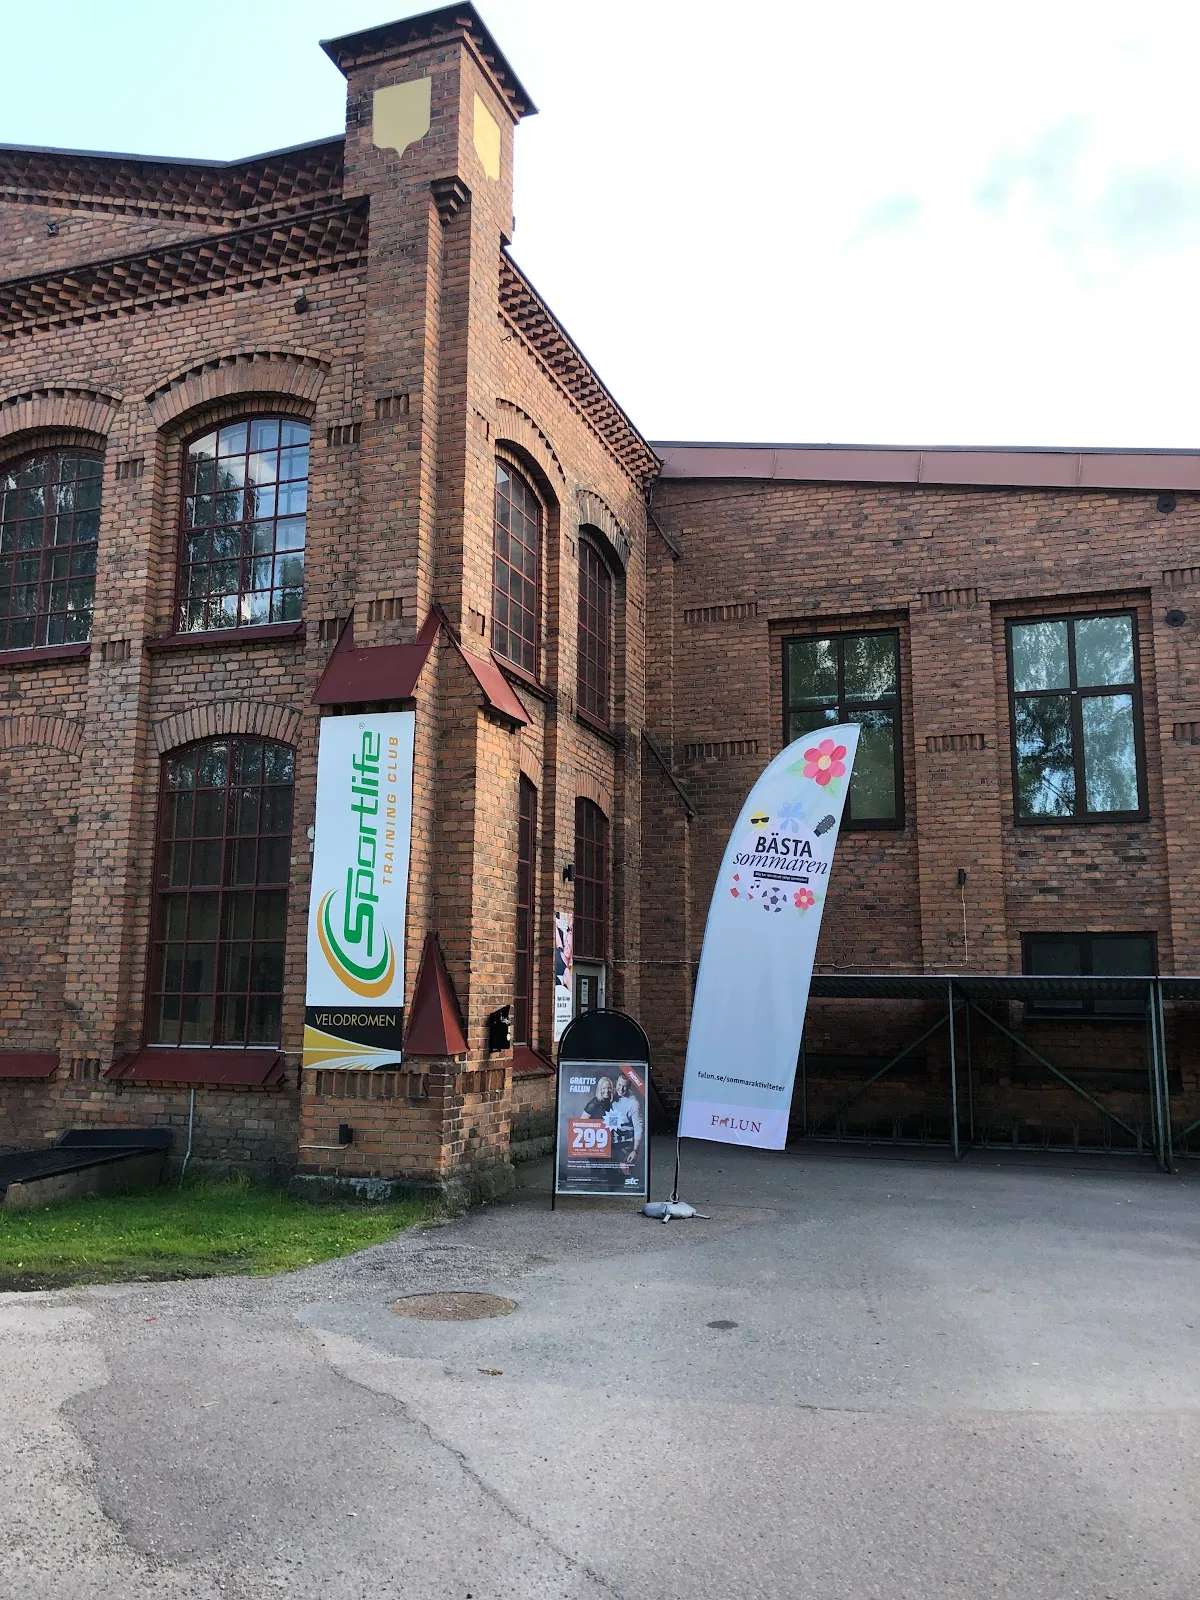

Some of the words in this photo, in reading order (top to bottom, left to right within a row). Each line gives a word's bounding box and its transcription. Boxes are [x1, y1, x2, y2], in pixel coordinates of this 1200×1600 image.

[388, 736, 399, 783] CLUB
[383, 794, 397, 885] TRAINING
[755, 832, 813, 858] BÄSTA
[732, 852, 828, 875] sommaren
[315, 1013, 396, 1027] VELODROMEN
[569, 1077, 597, 1085] GRATTIS
[569, 1085, 591, 1093] FALUN
[698, 1070, 785, 1092] falun.se/sommaraktiviteter
[572, 1128, 608, 1148] 299
[624, 1177, 640, 1185] stc
